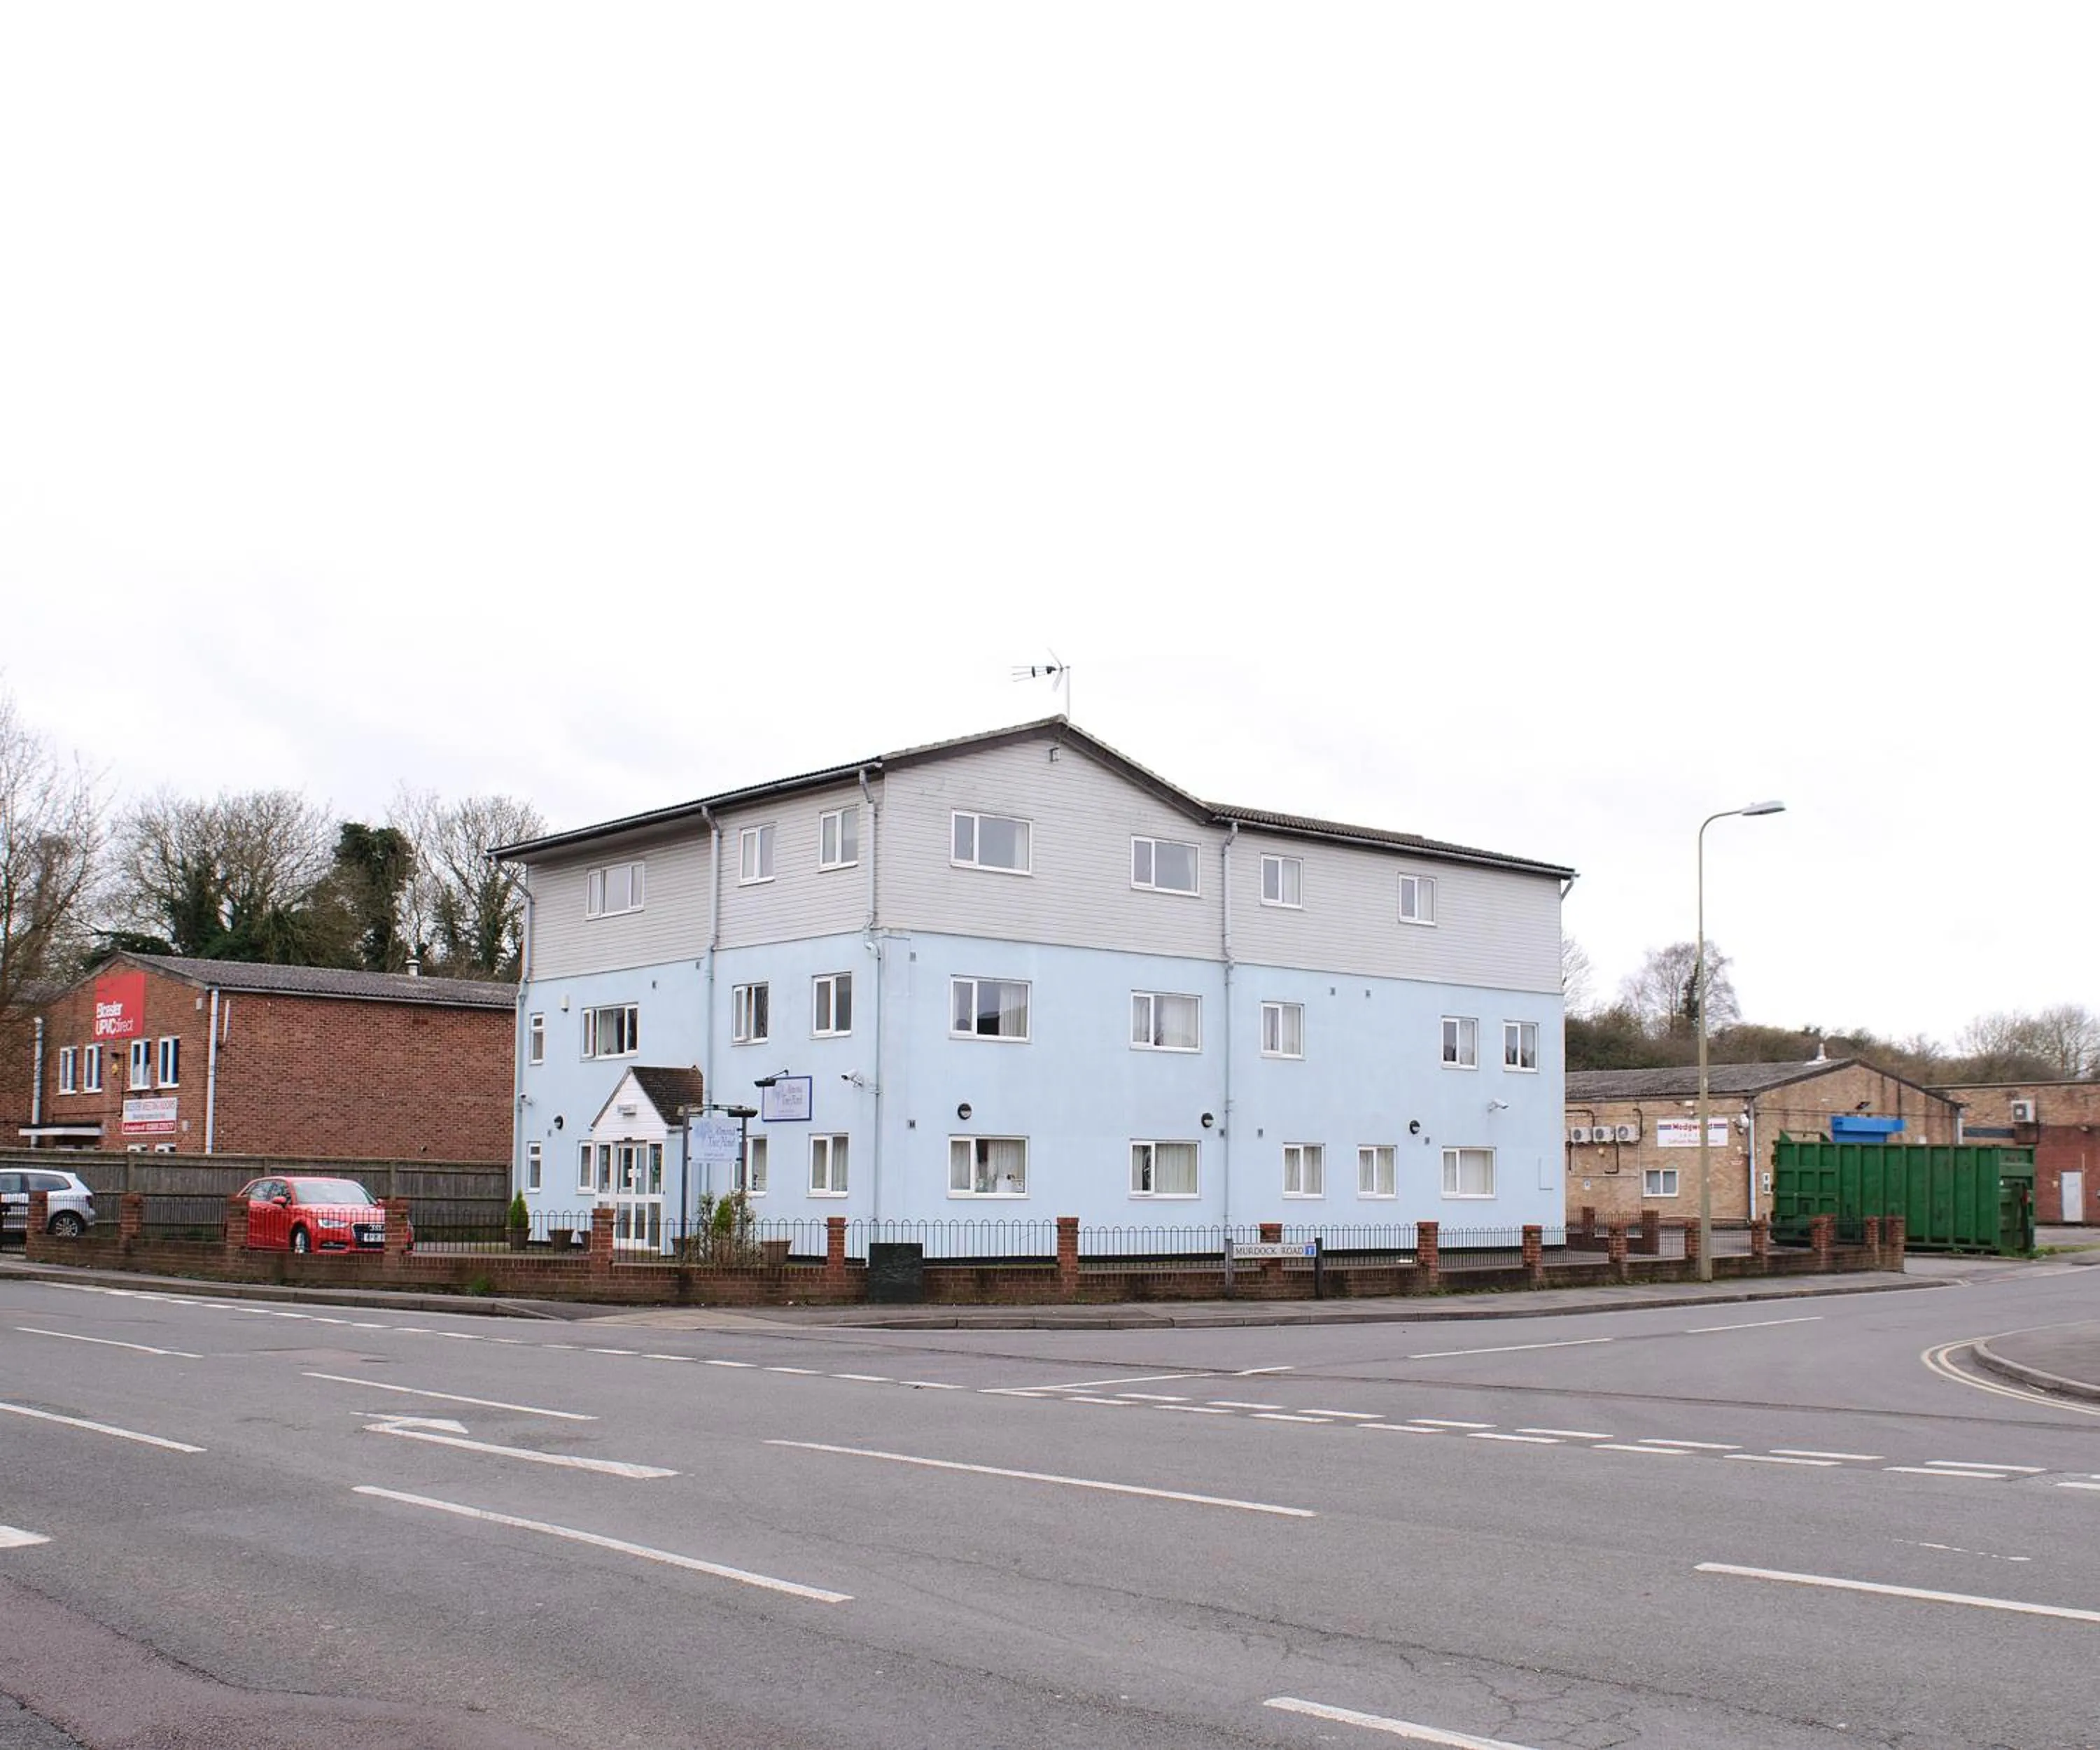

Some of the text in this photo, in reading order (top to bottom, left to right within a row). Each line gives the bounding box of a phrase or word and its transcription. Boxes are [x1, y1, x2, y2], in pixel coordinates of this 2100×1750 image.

[1672, 1122, 1714, 1132] Wedgwd
[1235, 1246, 1304, 1255] MURDOCK ROAD
